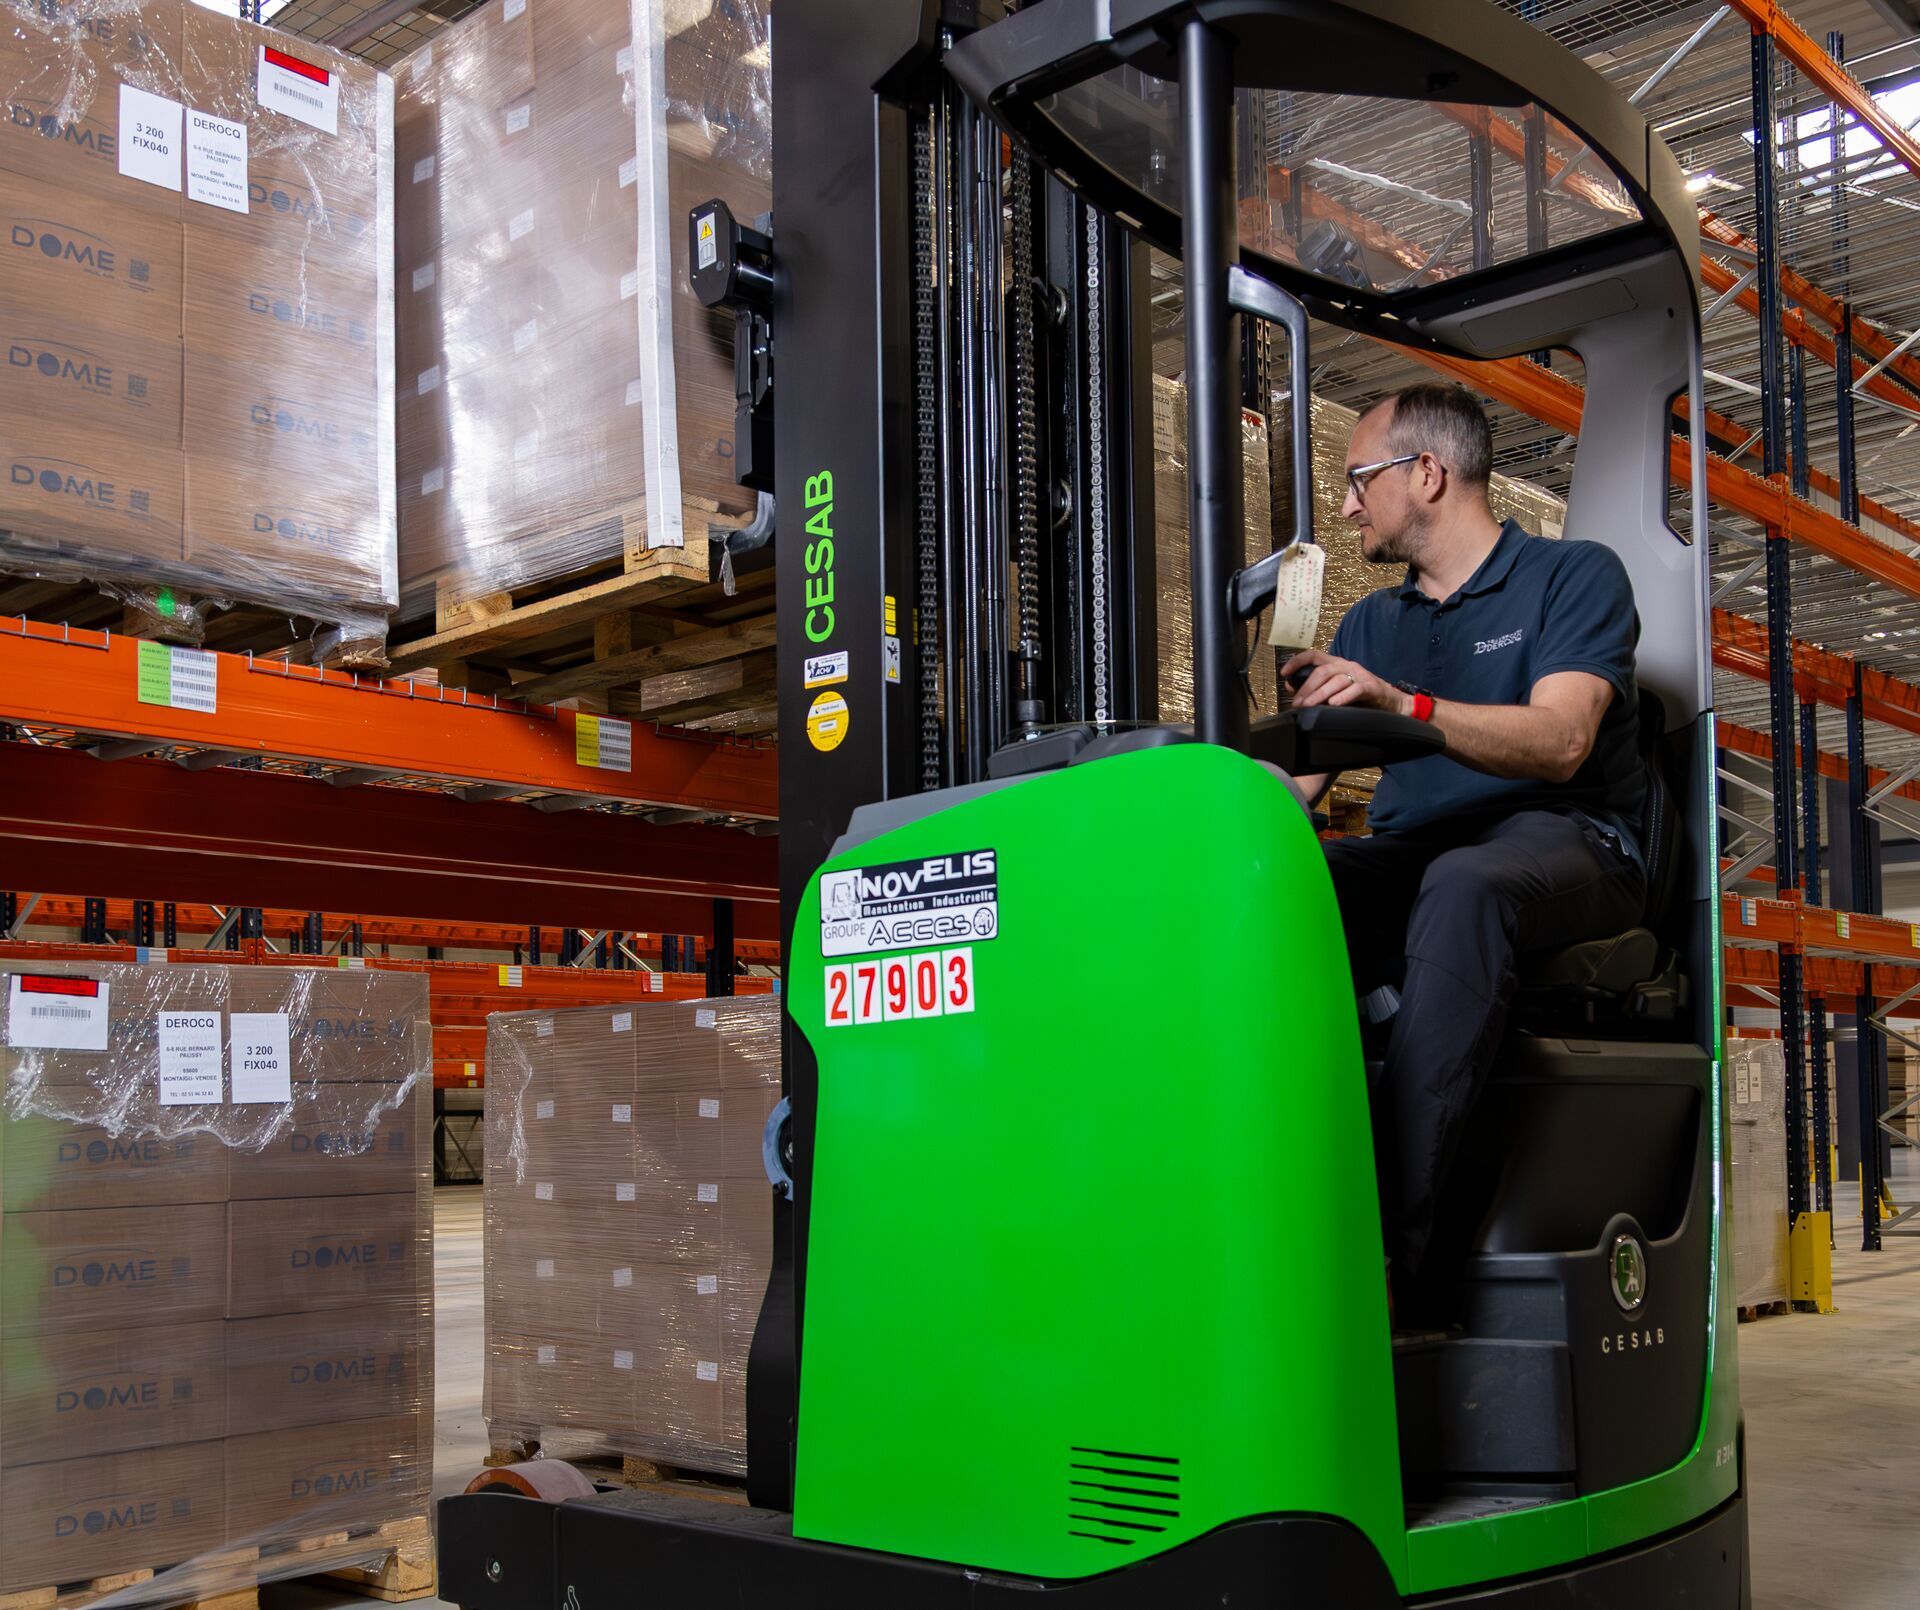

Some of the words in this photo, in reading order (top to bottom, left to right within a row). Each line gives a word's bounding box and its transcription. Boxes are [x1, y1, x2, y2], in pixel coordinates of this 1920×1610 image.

[136, 122, 143, 132] 3
[145, 126, 164, 139] 200
[193, 117, 241, 139] DEROCQ
[132, 135, 169, 155] FIX040
[12, 225, 115, 272] DOME
[9, 345, 113, 388] DOME
[11, 464, 114, 504] DOME
[804, 470, 835, 643] CESAB
[862, 851, 995, 899] NOVELIS
[863, 900, 925, 917] Manutention
[932, 890, 995, 908] Industrielle
[823, 921, 866, 939] GROUPE
[829, 956, 969, 1020] 27903
[165, 1018, 214, 1028] DEROCQ
[247, 1046, 253, 1055] 3
[255, 1046, 273, 1055] 200
[244, 1060, 278, 1070] FIX040
[58, 1139, 161, 1164] DOME
[292, 1245, 377, 1268] DOME
[54, 1260, 158, 1287] DOME
[1601, 1328, 1665, 1354] CESAB
[290, 1357, 377, 1384] DOME
[56, 1382, 158, 1413] DOME
[291, 1468, 378, 1498] DOME
[55, 1502, 157, 1538] DOME
